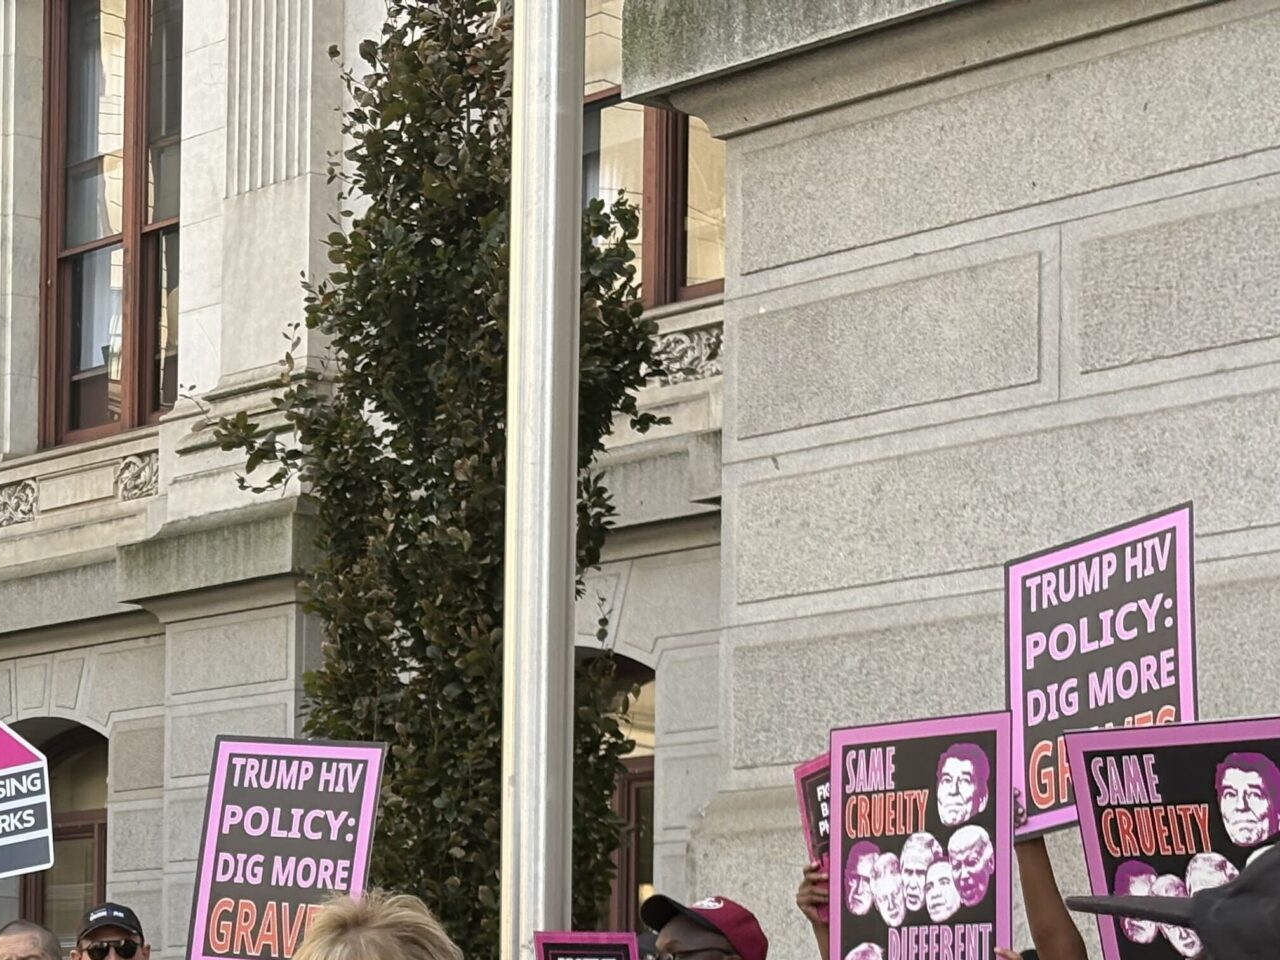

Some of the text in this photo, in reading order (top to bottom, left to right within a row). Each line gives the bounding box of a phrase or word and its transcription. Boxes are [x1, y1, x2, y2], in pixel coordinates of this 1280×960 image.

[1026, 532, 1171, 613] TRUMP HIV
[1026, 592, 1174, 670] POLICY:
[1027, 648, 1176, 727] DIG MORE
[232, 757, 364, 793] TRUMP HIV
[845, 746, 895, 794] SAME
[1091, 754, 1162, 807] SAME
[222, 804, 356, 843] POLICY:
[845, 789, 929, 839] CRUELTY
[1101, 804, 1211, 858] CRUELTY
[216, 852, 351, 891] DIG MORE
